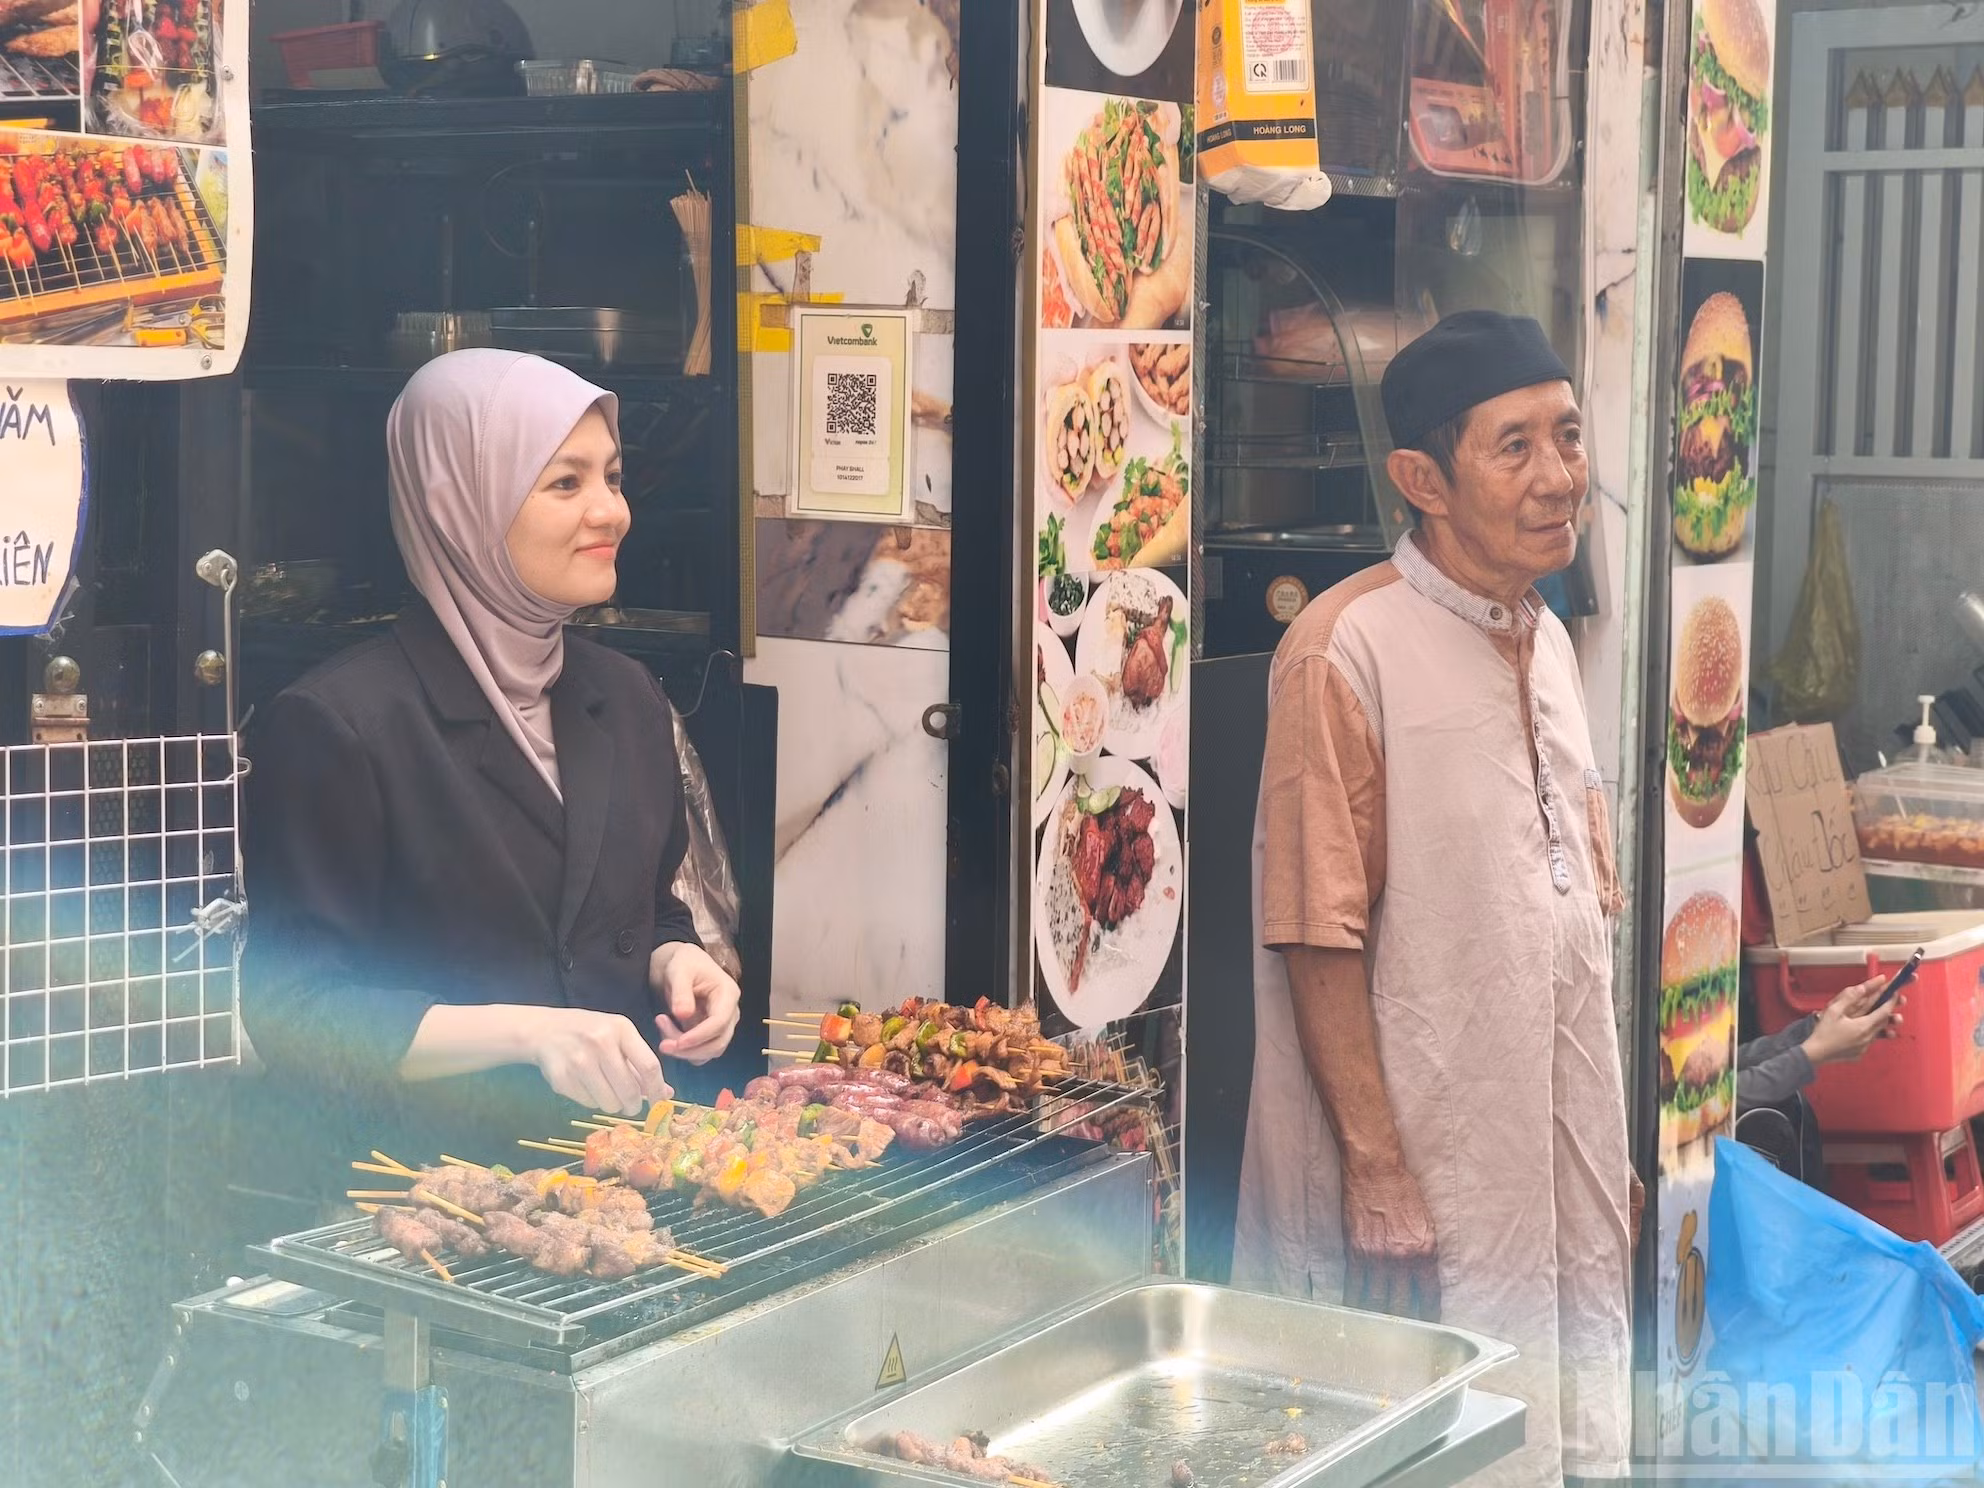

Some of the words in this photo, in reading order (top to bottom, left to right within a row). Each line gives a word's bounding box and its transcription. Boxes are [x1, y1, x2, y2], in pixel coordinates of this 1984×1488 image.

[1253, 124, 1281, 135] HOÀNG
[1283, 124, 1306, 134] LONG
[827, 335, 878, 346] Vietcombank
